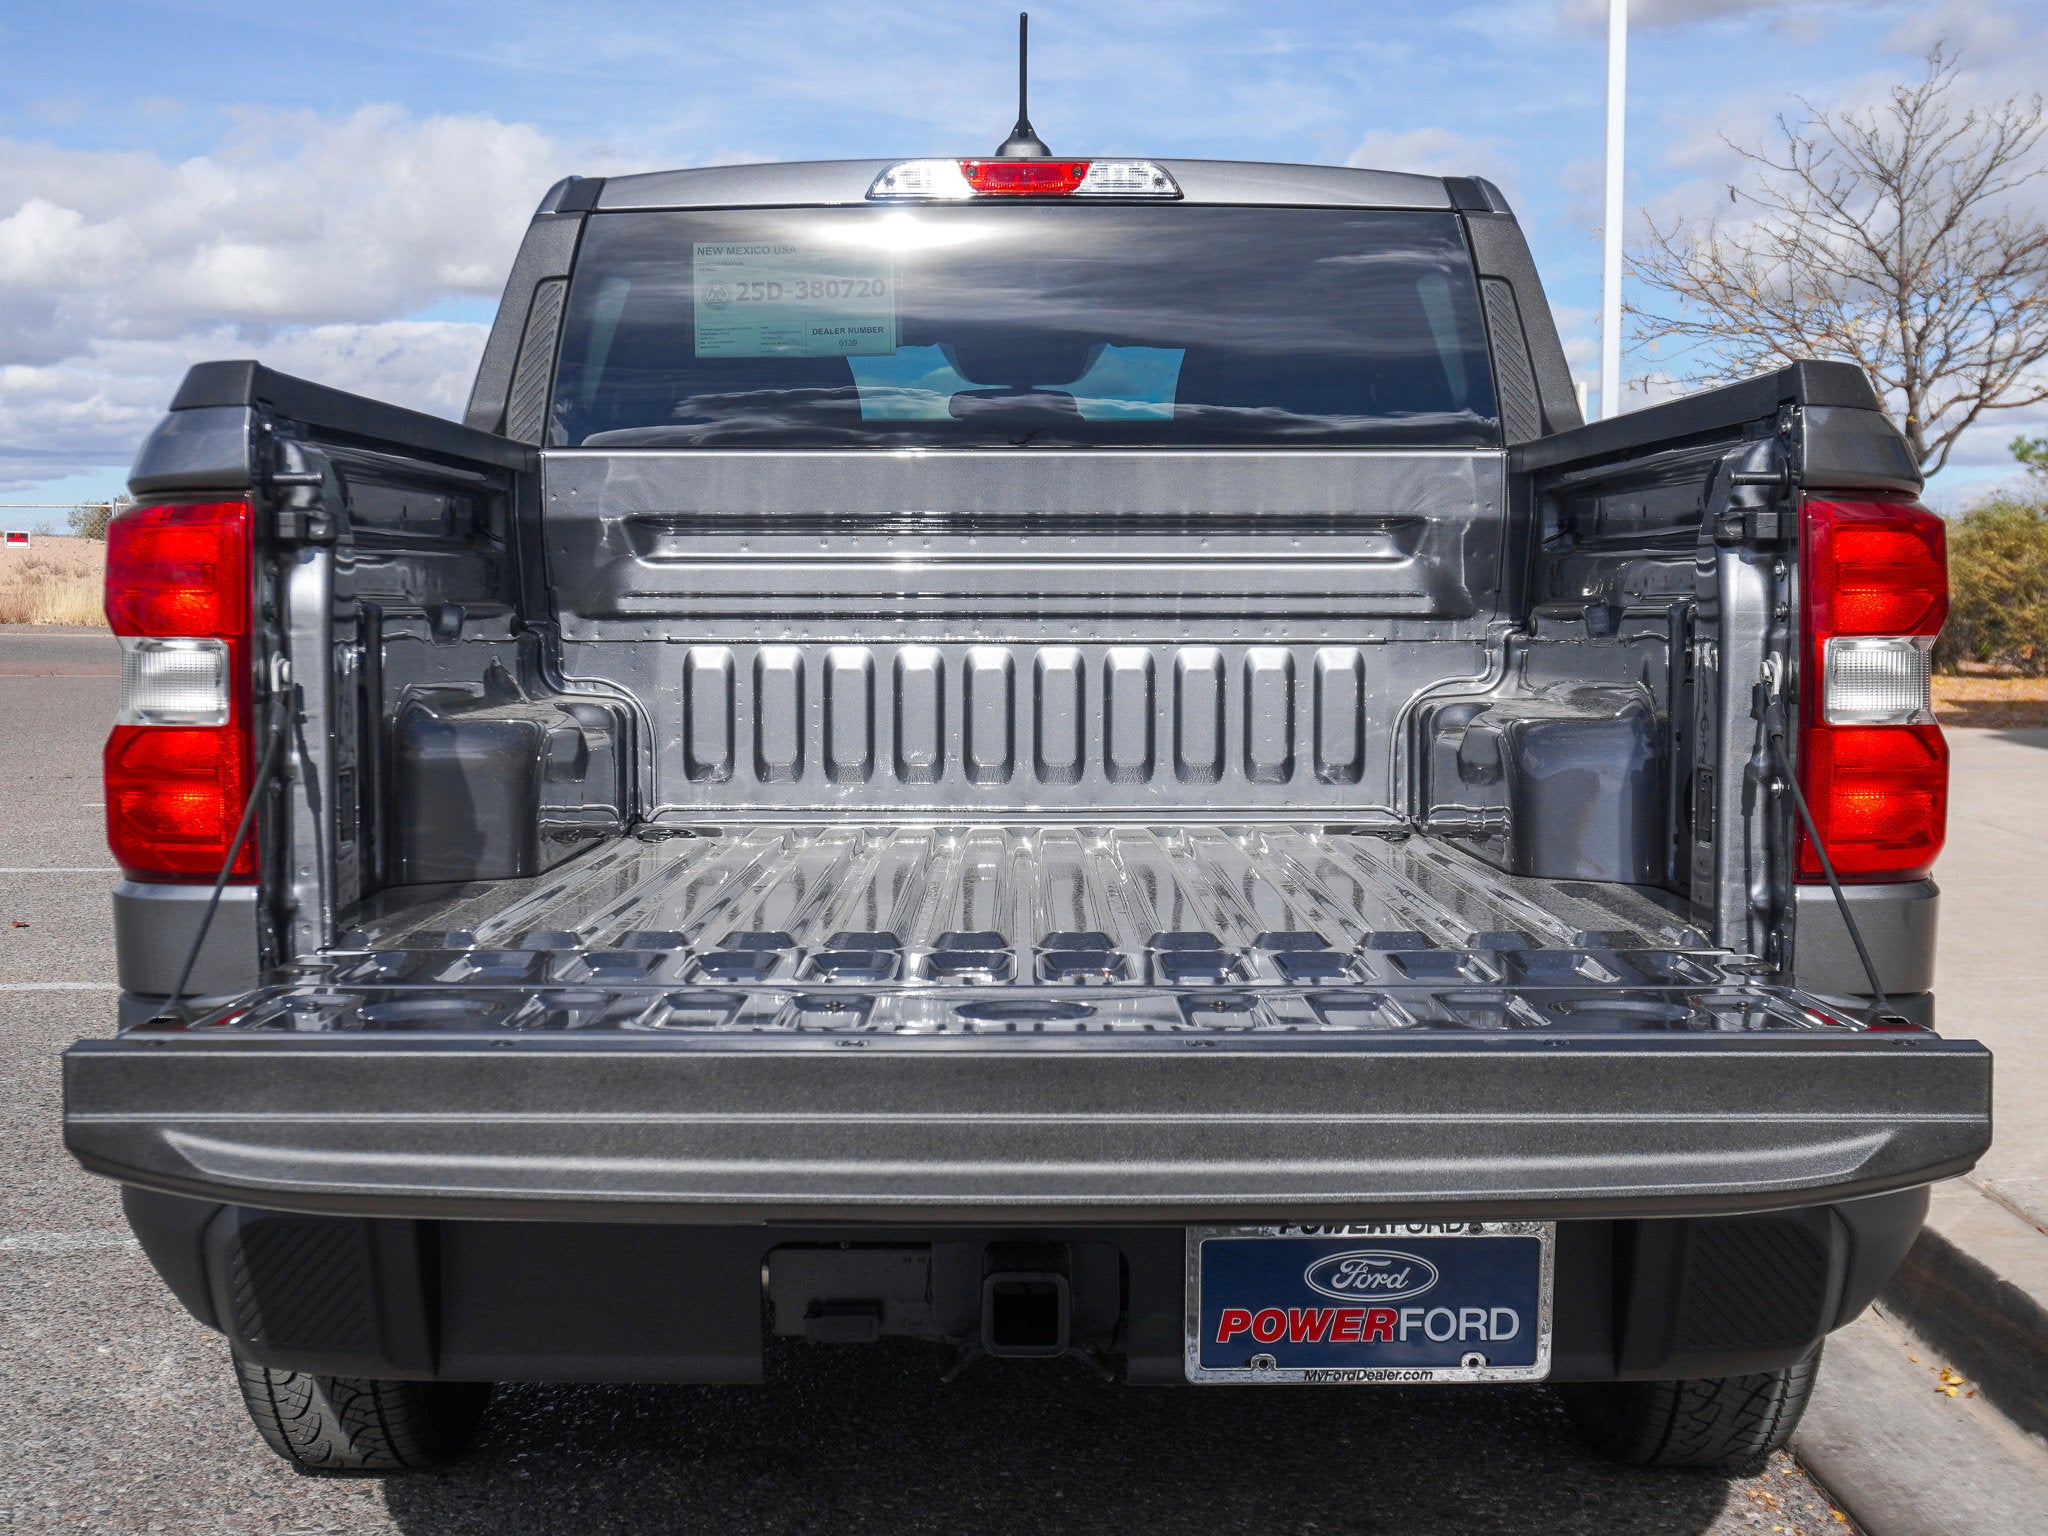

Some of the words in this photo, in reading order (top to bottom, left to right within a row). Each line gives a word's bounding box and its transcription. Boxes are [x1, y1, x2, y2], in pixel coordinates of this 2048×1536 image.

[697, 247, 724, 256] NEW
[726, 246, 771, 255] MEXICO
[773, 245, 797, 254] USA
[736, 278, 886, 301] 25D-380720
[812, 327, 846, 336] DEALER
[847, 326, 884, 334] NUMBER
[1331, 1258, 1410, 1290] Ford
[1215, 1307, 1520, 1344] POWERFORD
[1303, 1368, 1434, 1383] MyFordDealer.com
